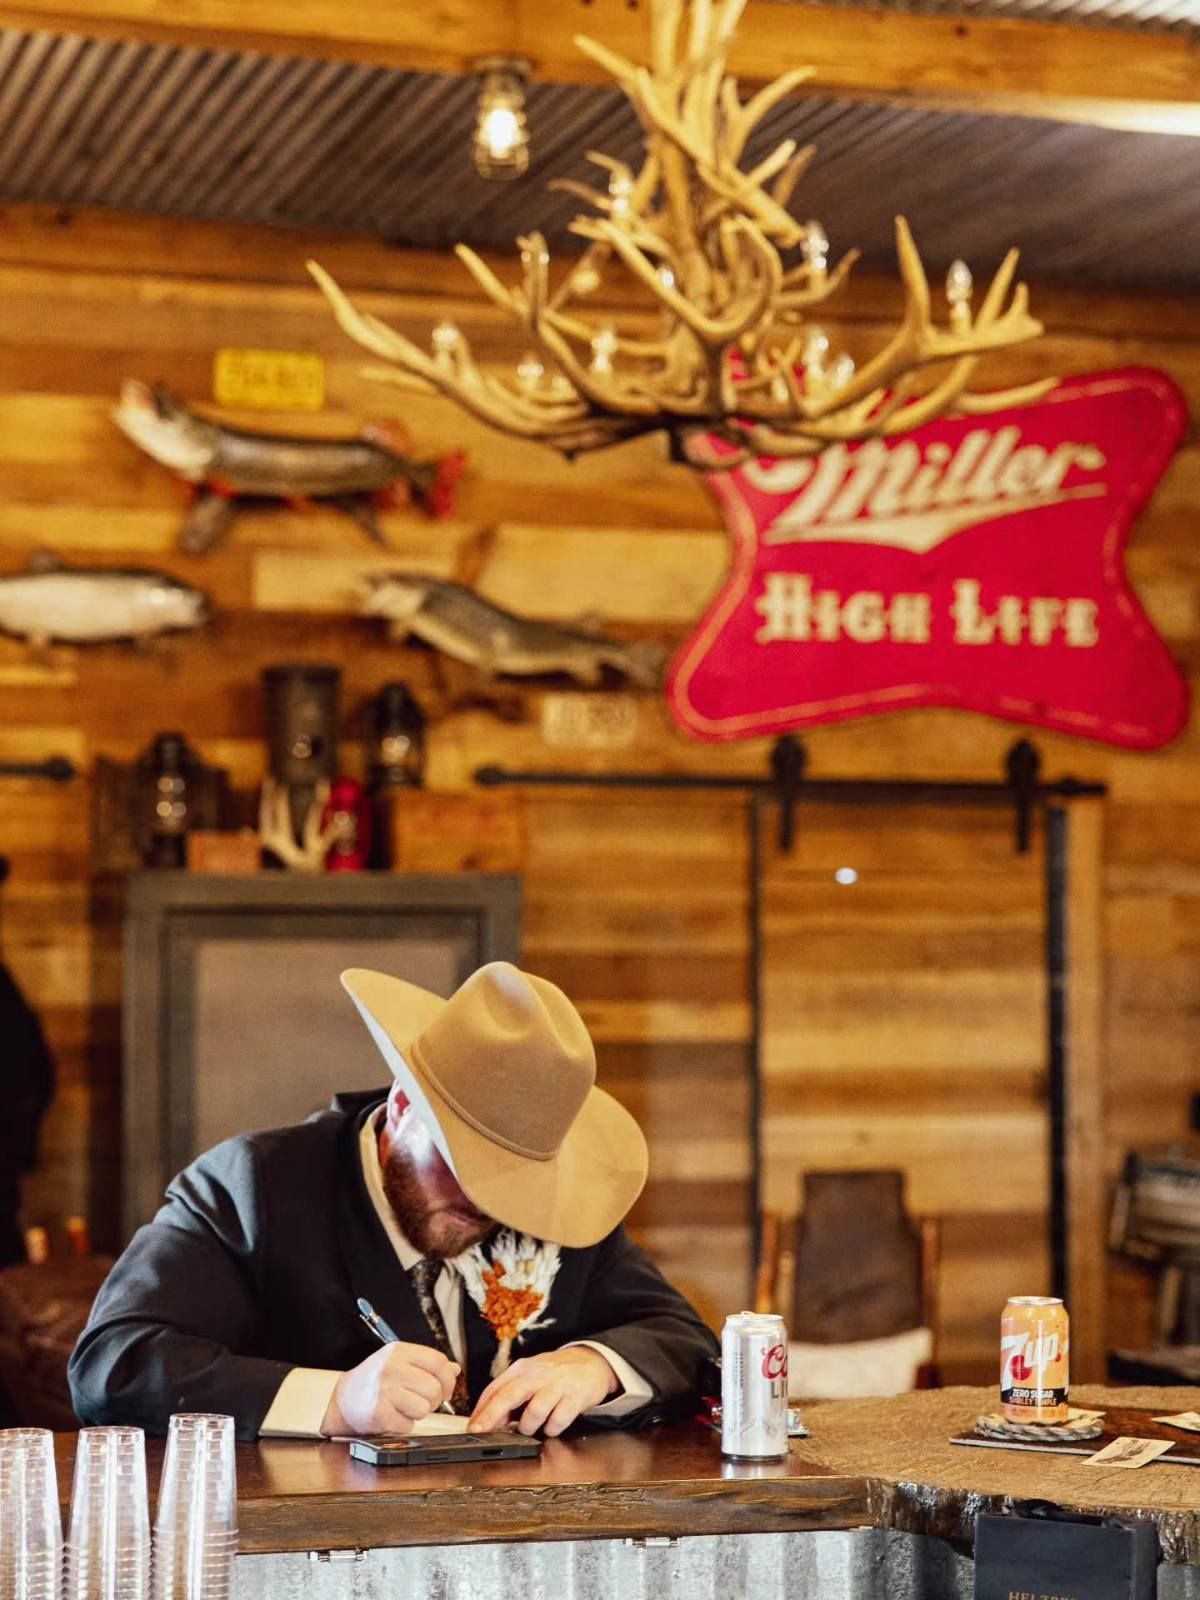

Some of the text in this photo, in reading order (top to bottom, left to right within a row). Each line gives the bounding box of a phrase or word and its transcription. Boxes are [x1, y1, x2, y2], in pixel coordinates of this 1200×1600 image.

[740, 426, 1107, 532] Miller
[755, 571, 1100, 648] HIGH LIFE
[1012, 1388, 1030, 1398] ZERO
